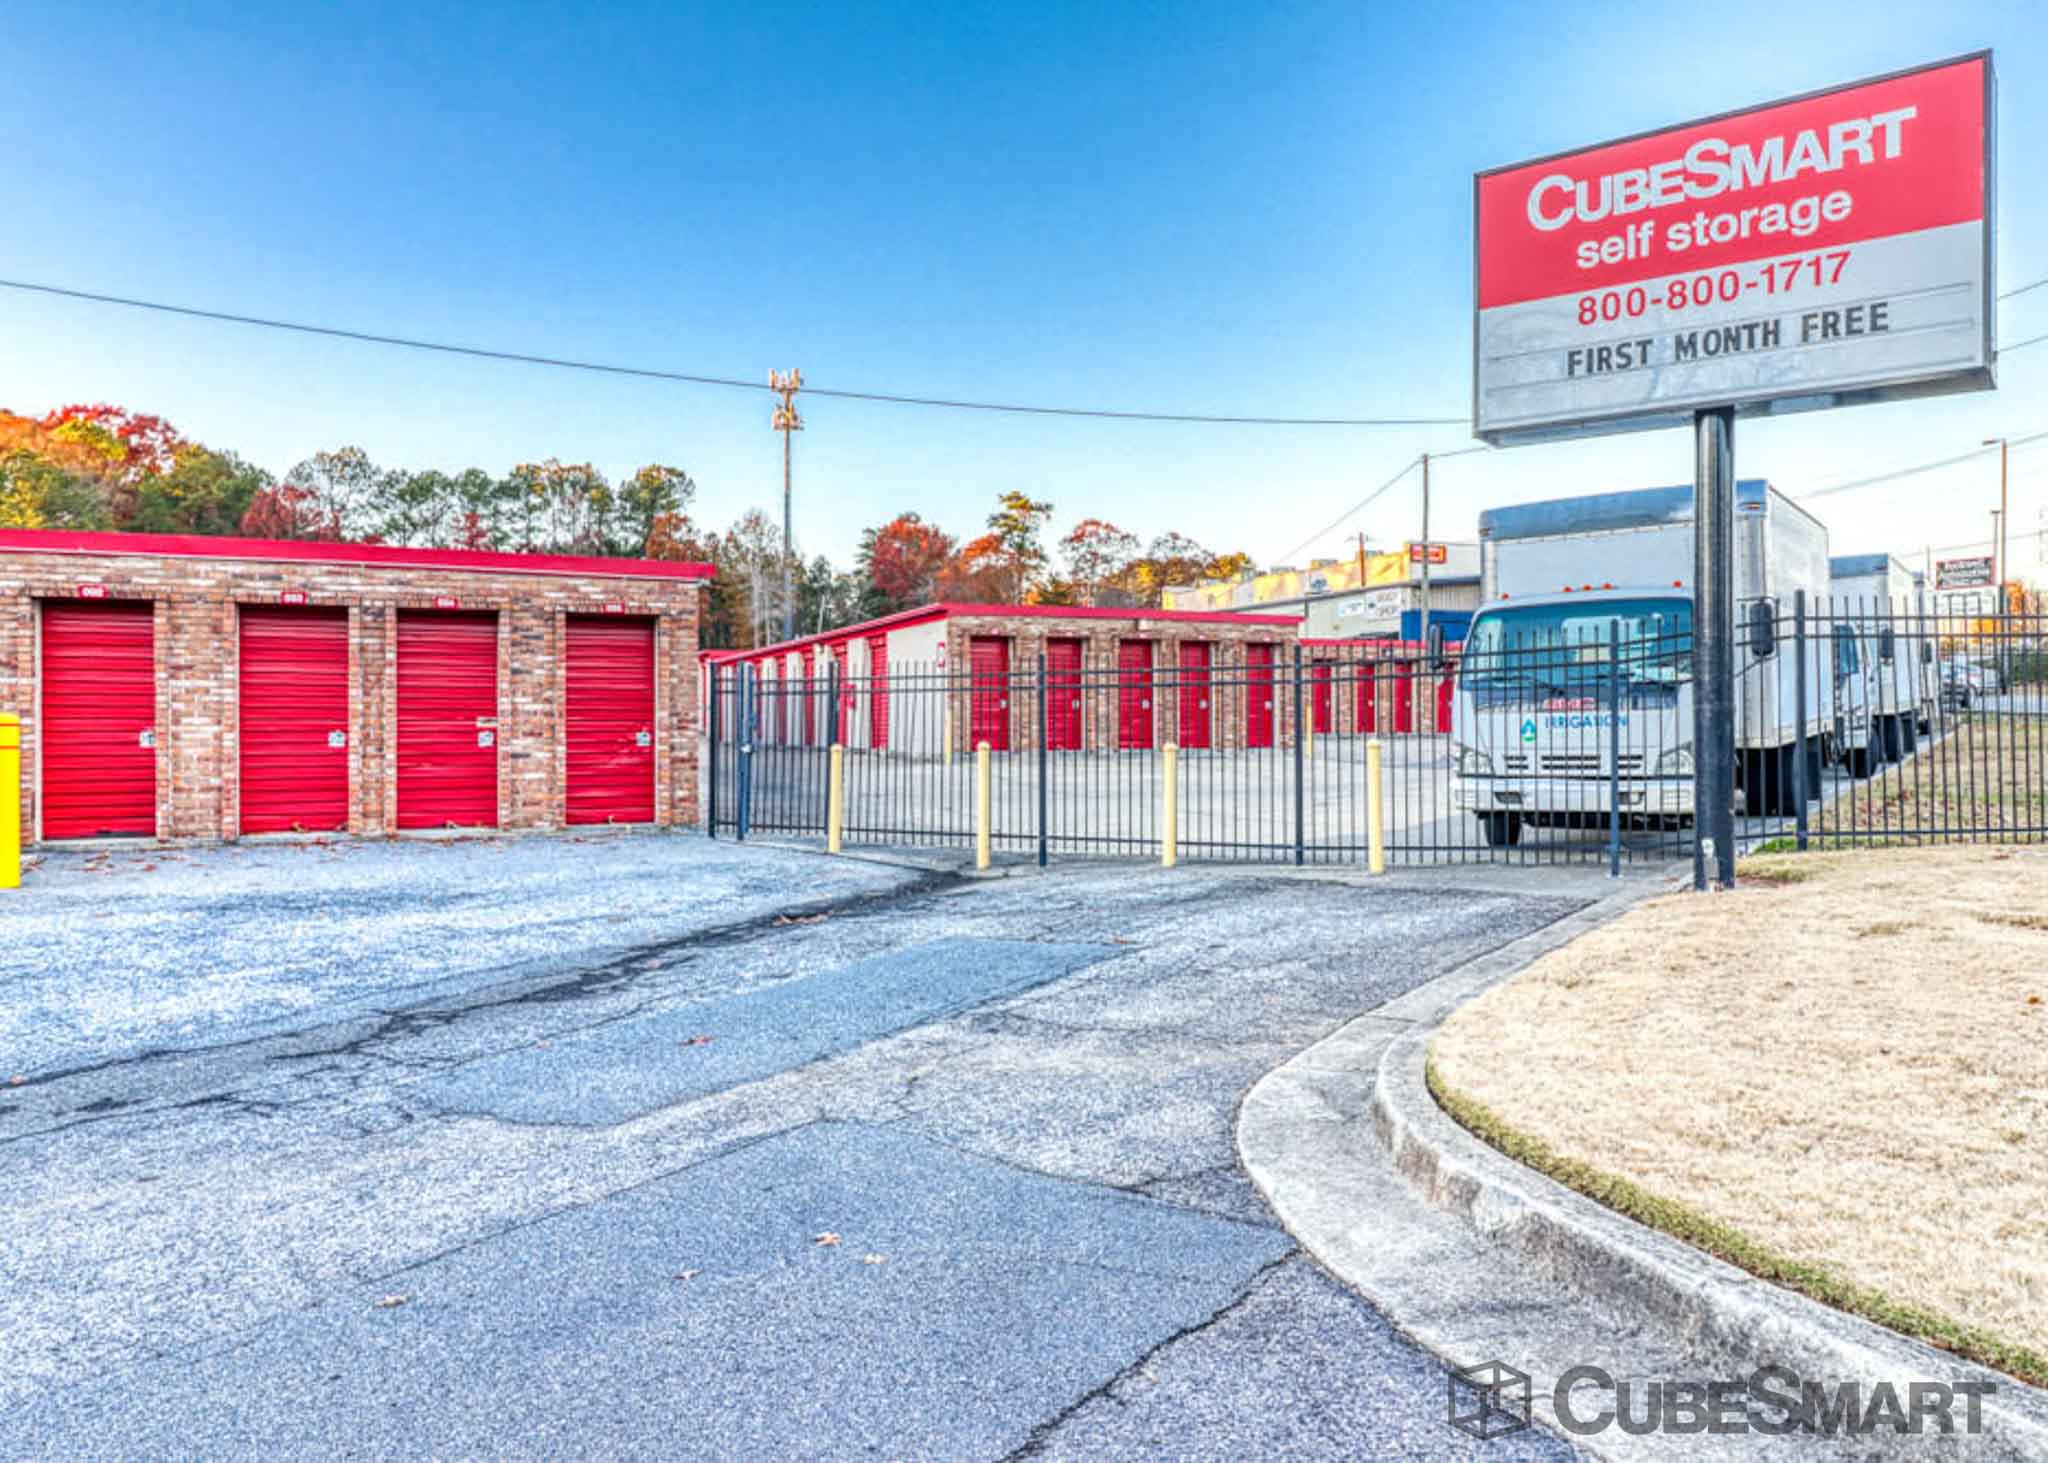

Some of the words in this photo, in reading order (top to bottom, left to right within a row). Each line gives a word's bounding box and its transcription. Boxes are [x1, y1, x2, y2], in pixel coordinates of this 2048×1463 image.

[1576, 219, 1654, 269] self
[1666, 186, 1854, 253] storage
[1577, 250, 1852, 326] 800-800-1717
[1566, 338, 1653, 377] FIRST
[1674, 318, 1781, 362] MONTH
[1802, 302, 1889, 345] FREE
